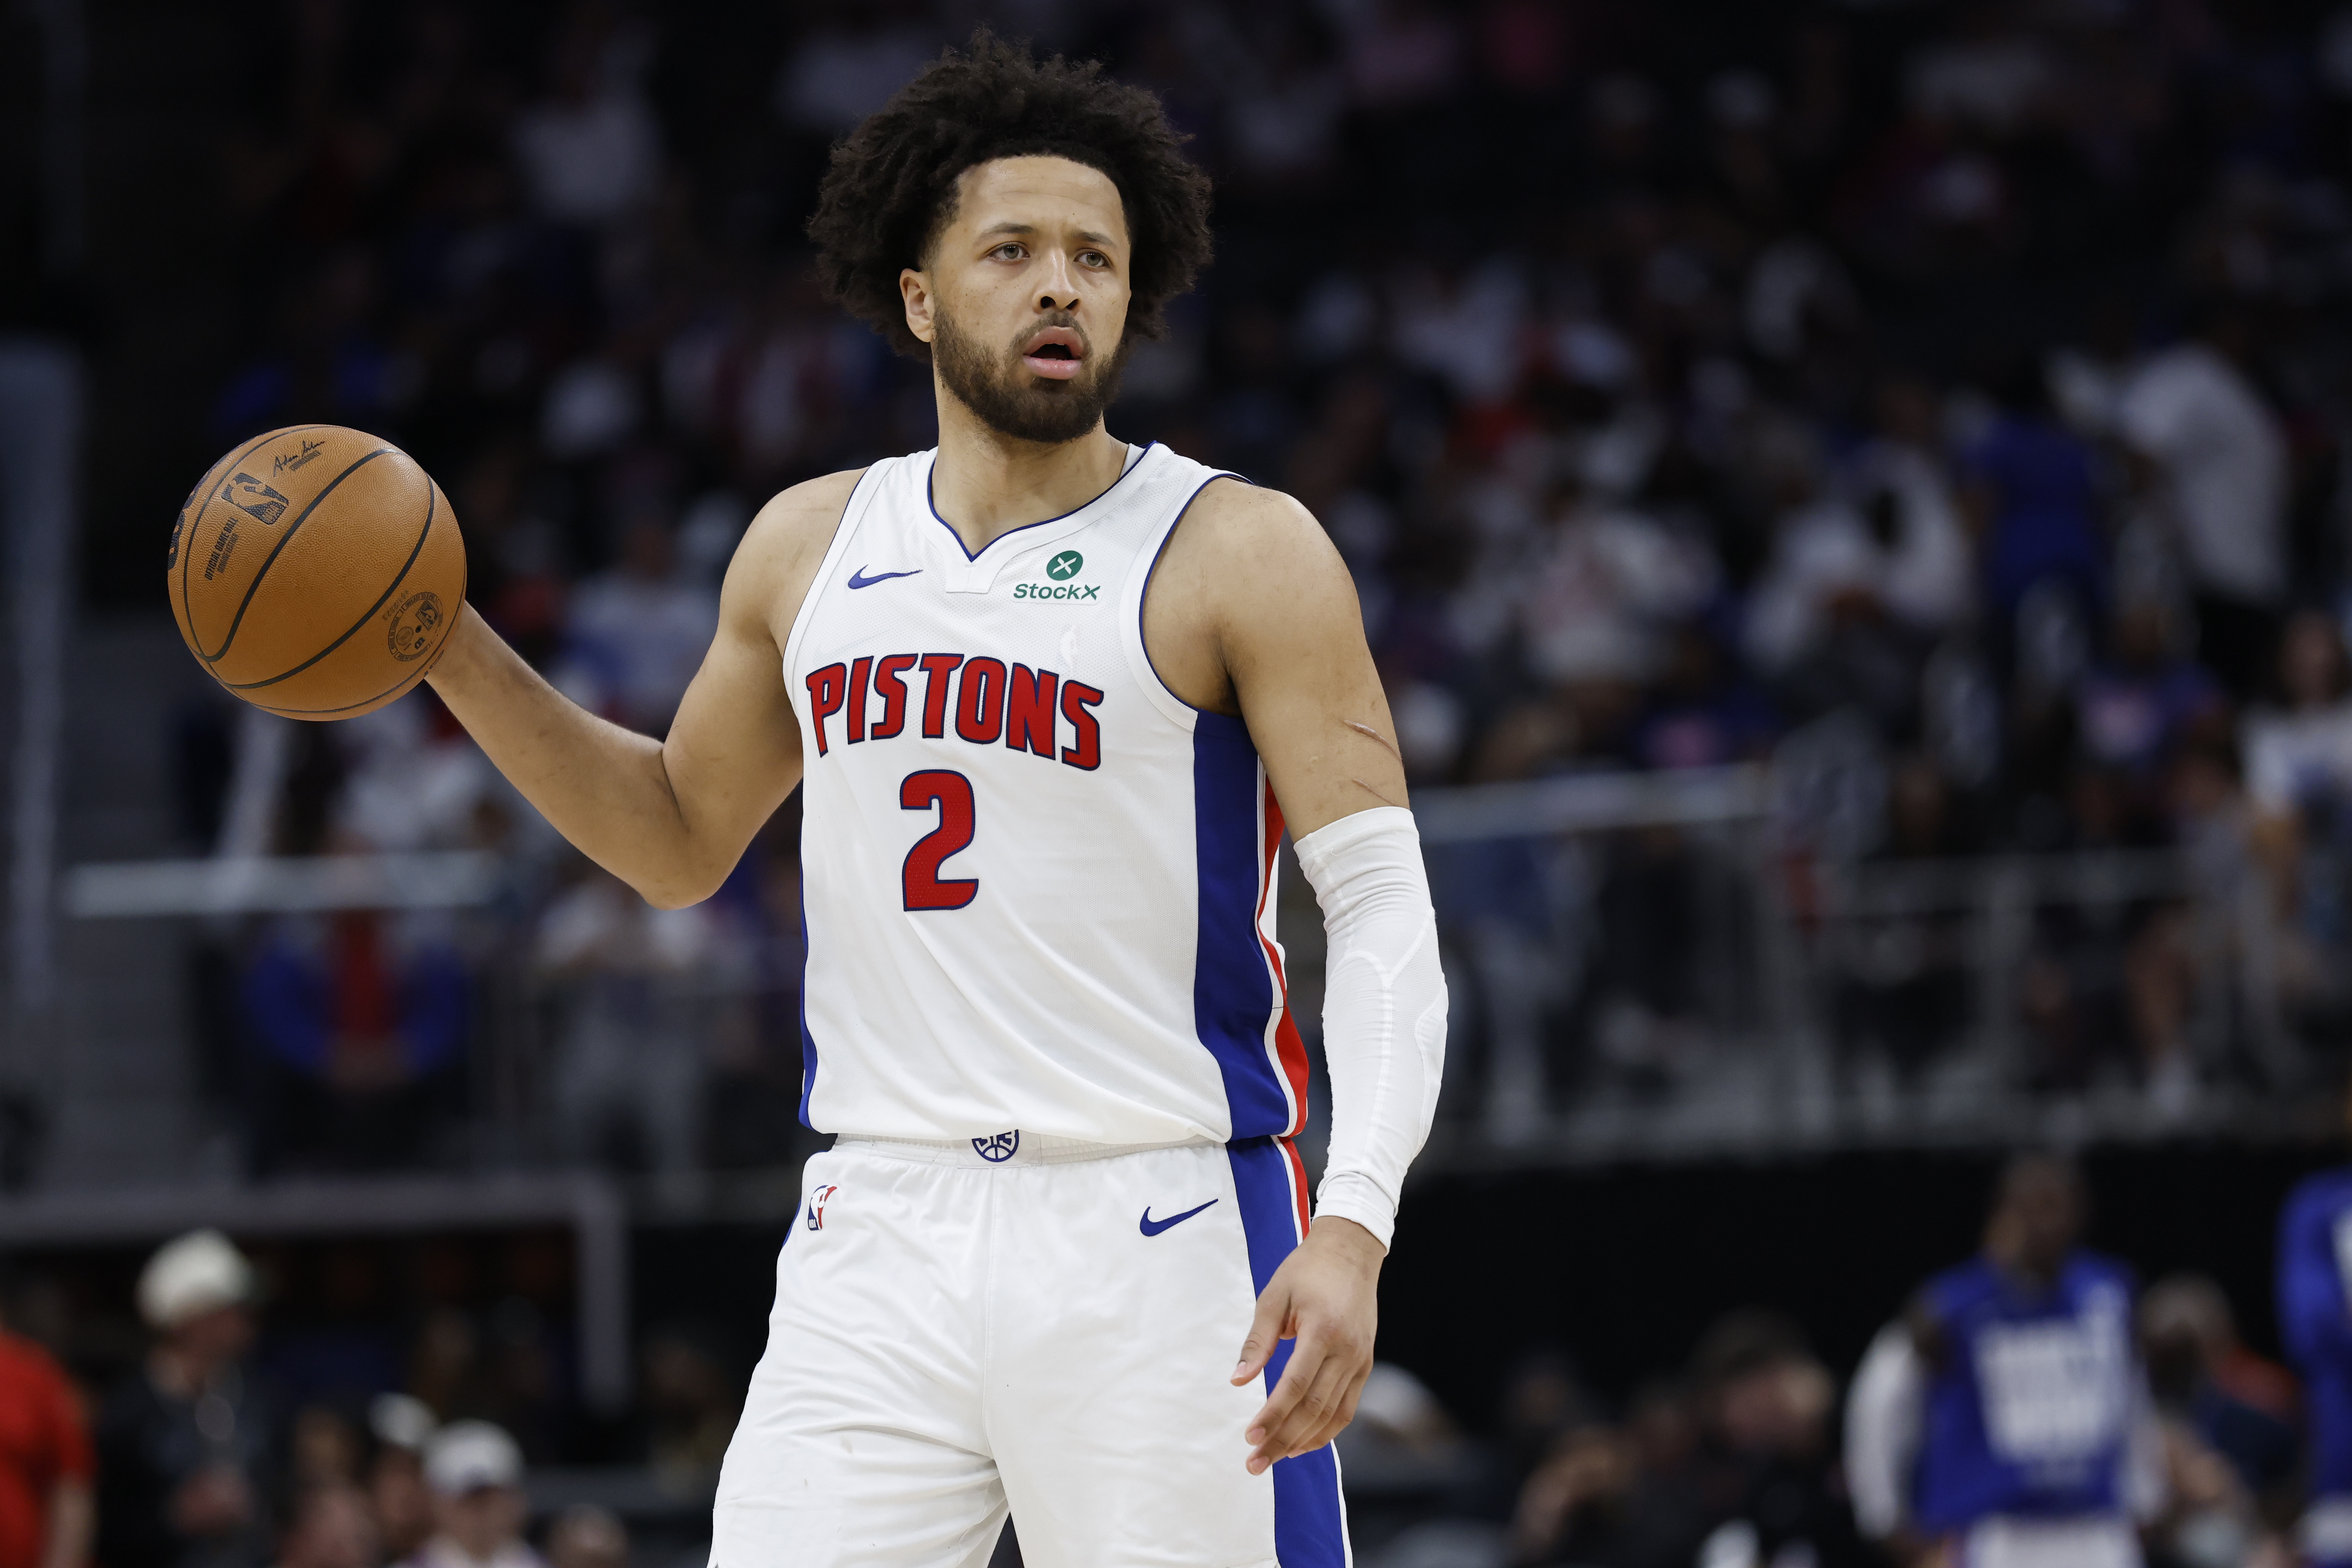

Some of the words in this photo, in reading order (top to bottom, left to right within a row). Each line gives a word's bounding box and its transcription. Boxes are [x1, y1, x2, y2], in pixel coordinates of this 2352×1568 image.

[289, 450, 321, 471] COMMISSIONER
[205, 552, 220, 580] OFFICIAL
[215, 531, 229, 552] GAME
[223, 517, 238, 533] BALL
[217, 552, 230, 573] GENUINE
[225, 533, 239, 553] LEATHER
[1013, 583, 1100, 600] StockX
[806, 653, 1104, 771] PISTONS
[900, 769, 979, 911] 2
[808, 1219, 817, 1228] NBA
